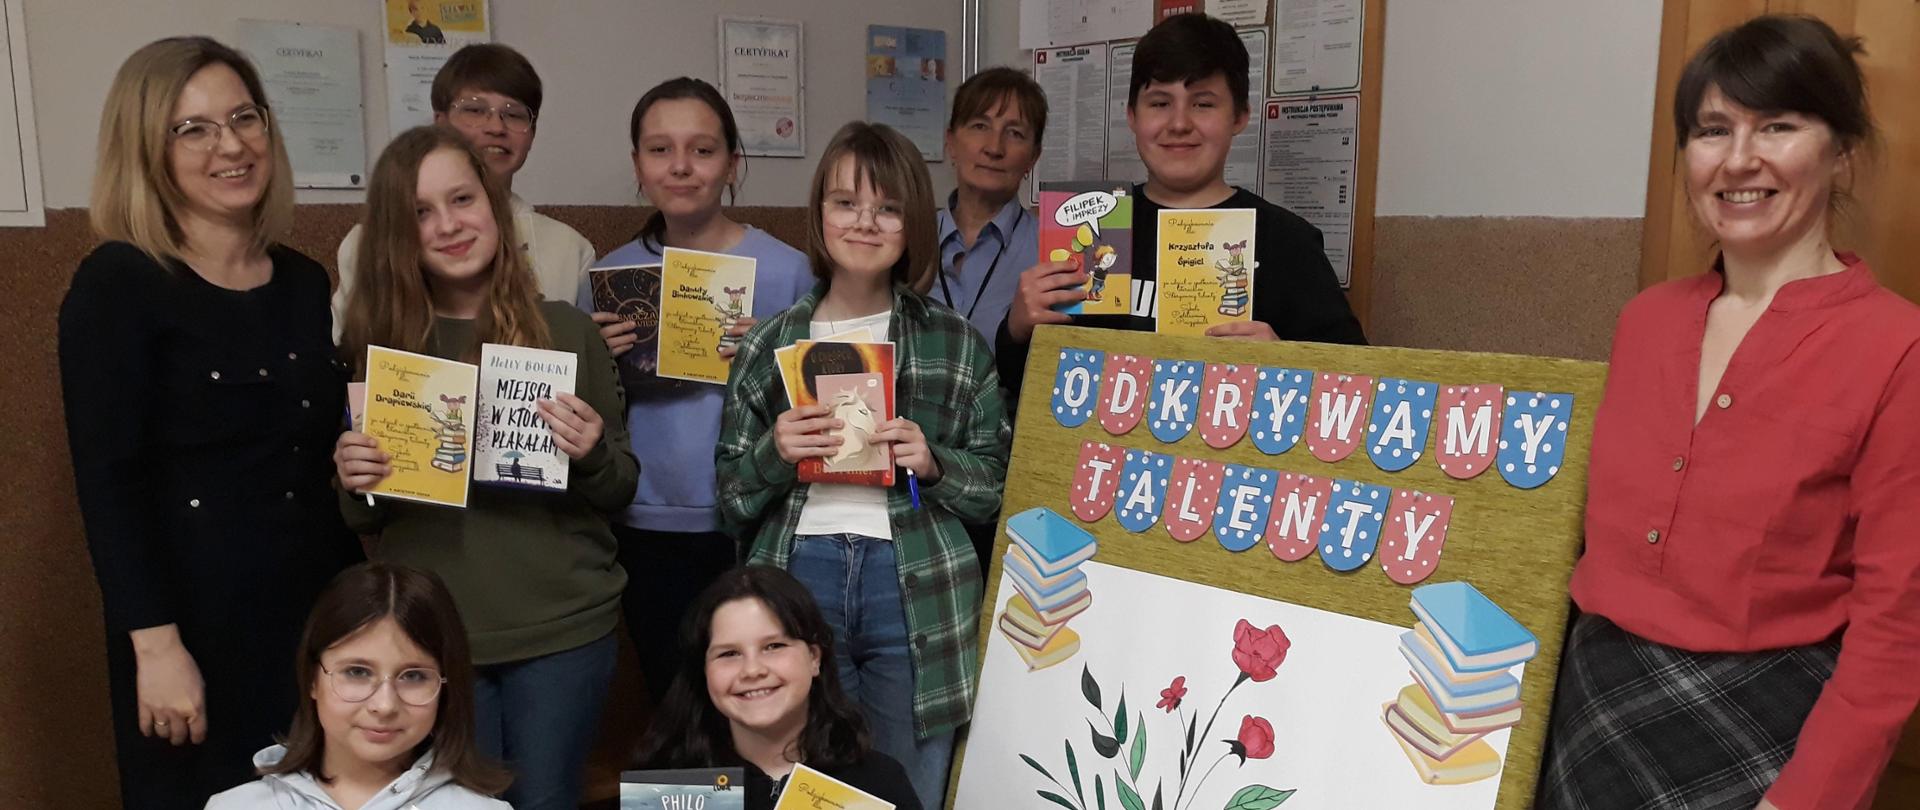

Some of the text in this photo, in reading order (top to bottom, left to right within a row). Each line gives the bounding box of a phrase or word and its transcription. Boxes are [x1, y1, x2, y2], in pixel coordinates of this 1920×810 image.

[734, 46, 790, 59] CERTYFIKAT
[1063, 195, 1104, 216] FILIPEK
[1072, 203, 1109, 221] IMPREZY
[1168, 242, 1215, 251] Krzysztofa
[496, 378, 552, 402] MIEJSCA
[491, 405, 506, 425] W
[1064, 366, 1556, 464] ODKRYWAMY
[491, 430, 559, 457] PŁAKAŁAM
[1087, 459, 1435, 561] TALENTY
[661, 793, 705, 810] PHILO
